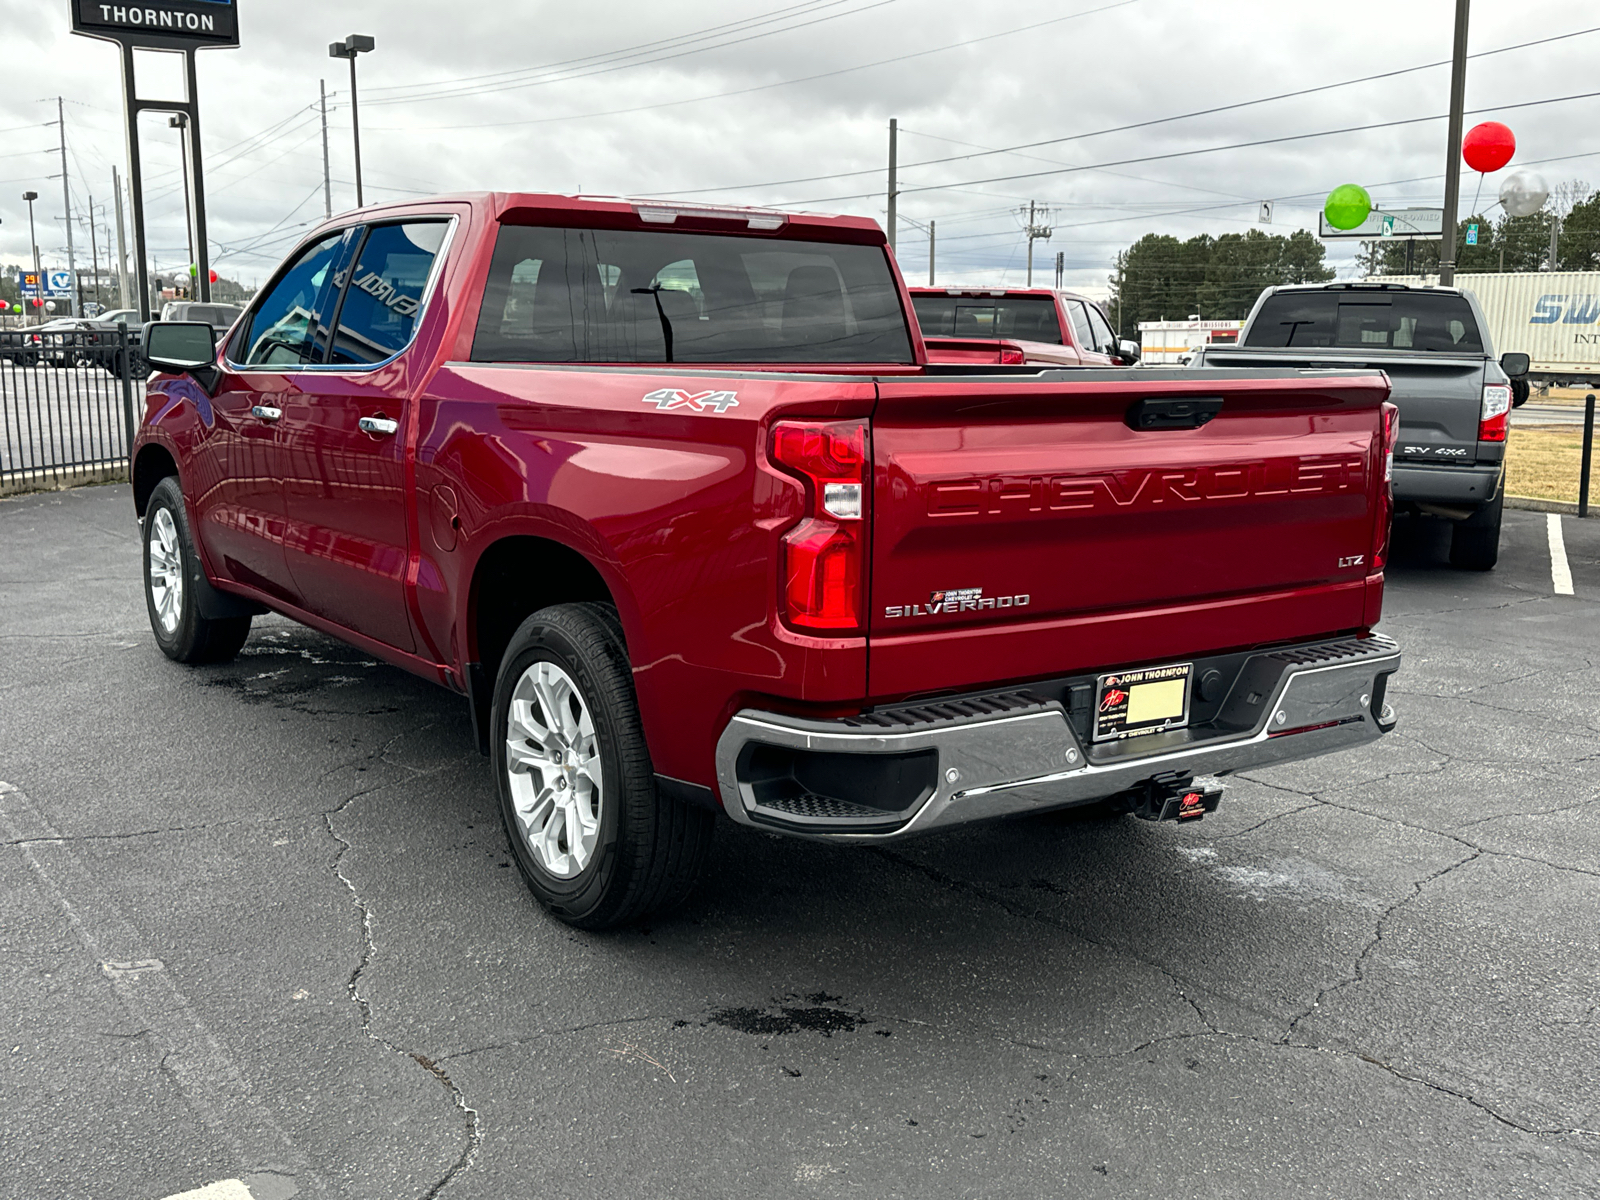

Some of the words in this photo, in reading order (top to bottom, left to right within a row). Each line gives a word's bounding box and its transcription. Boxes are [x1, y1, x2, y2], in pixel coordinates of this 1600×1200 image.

[100, 5, 214, 31] THORNTON
[927, 461, 1362, 516] CHEVROLET
[1338, 554, 1365, 568] LTZ
[885, 594, 1030, 618] SILVERADO
[1121, 672, 1143, 684] JOHN
[1145, 666, 1188, 680] THORNTON
[1128, 728, 1155, 737] CHEVROLET
